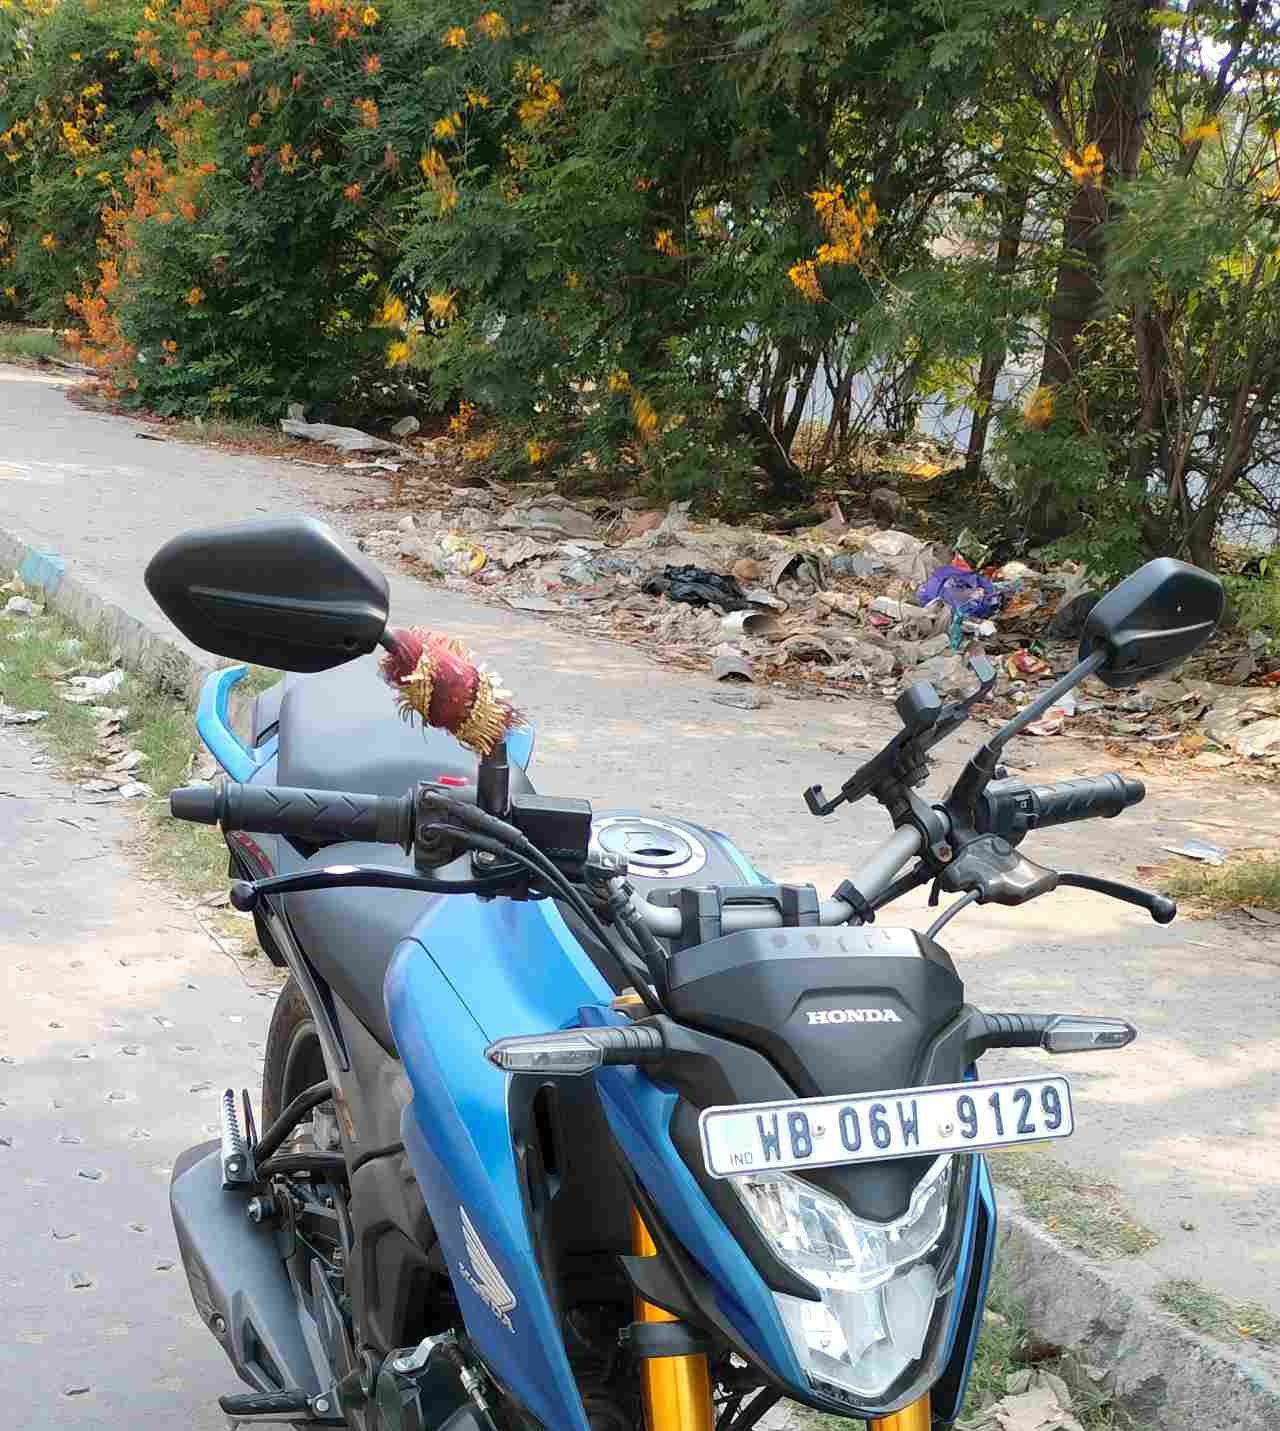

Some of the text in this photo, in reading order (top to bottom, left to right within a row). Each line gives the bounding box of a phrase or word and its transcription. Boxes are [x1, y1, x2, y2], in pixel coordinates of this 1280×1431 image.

[806, 1008, 902, 1025] HONDA
[757, 1085, 1063, 1162] WB 06W 9129
[729, 1153, 753, 1167] IND
